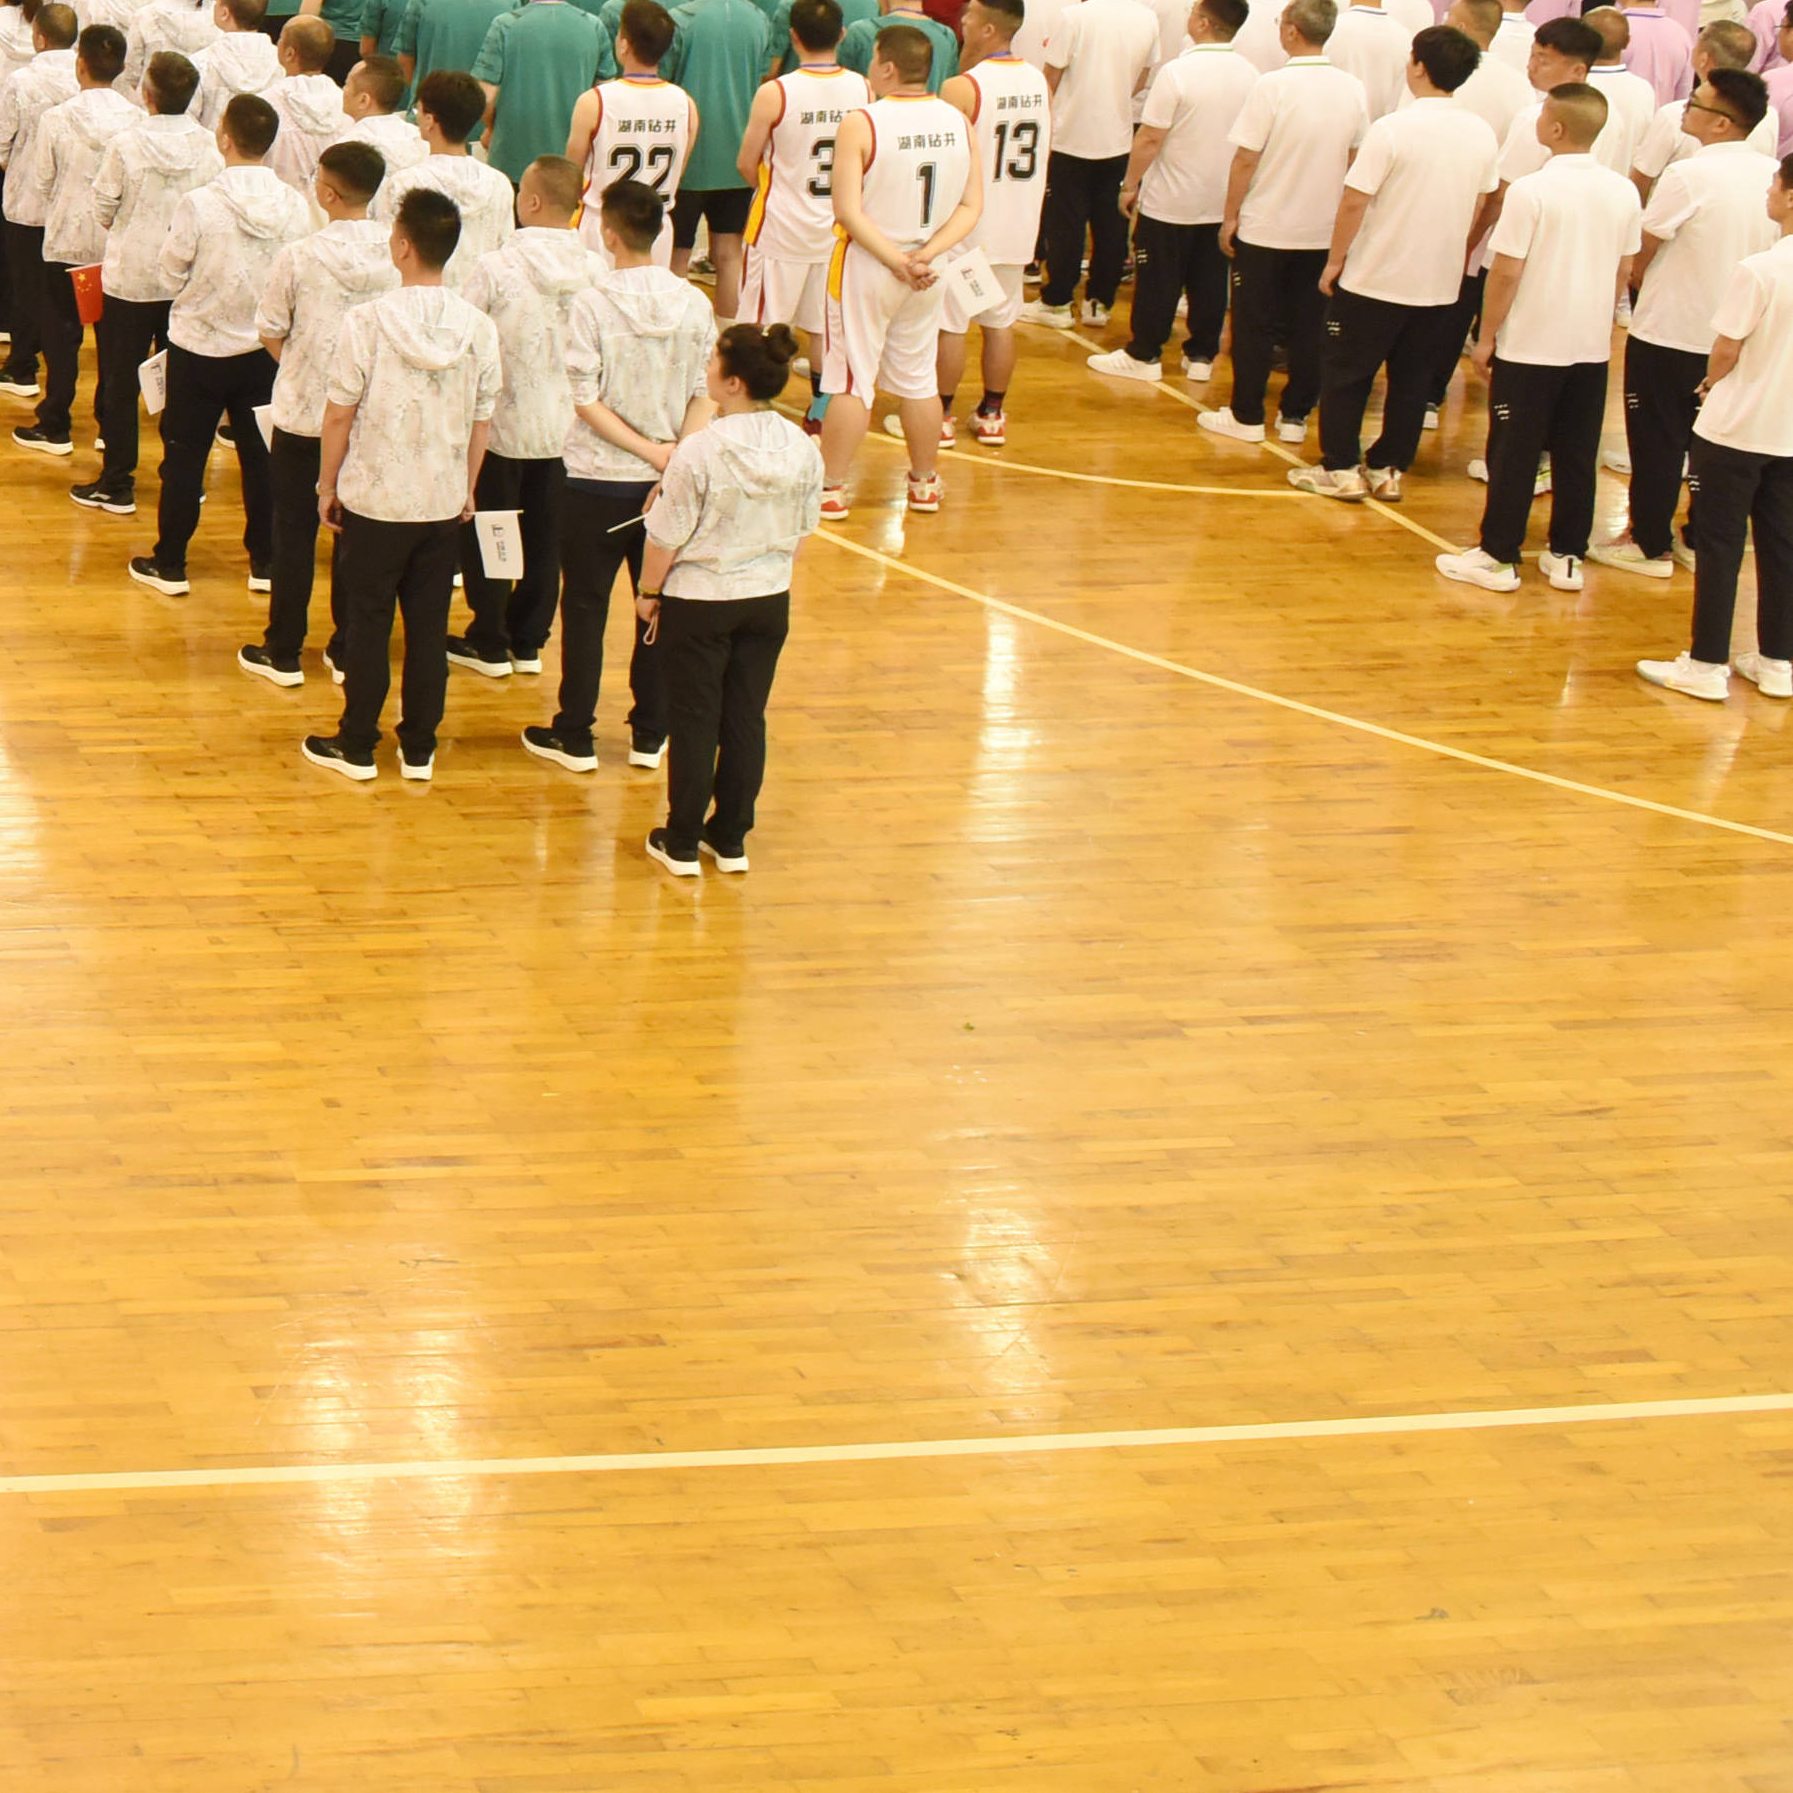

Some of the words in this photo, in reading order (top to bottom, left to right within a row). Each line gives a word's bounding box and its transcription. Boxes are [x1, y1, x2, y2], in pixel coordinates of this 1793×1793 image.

[618, 119, 676, 134] 湖南钻井
[897, 132, 955, 150] 湖南钻井
[992, 119, 1040, 183] 13
[916, 161, 937, 228] 1
